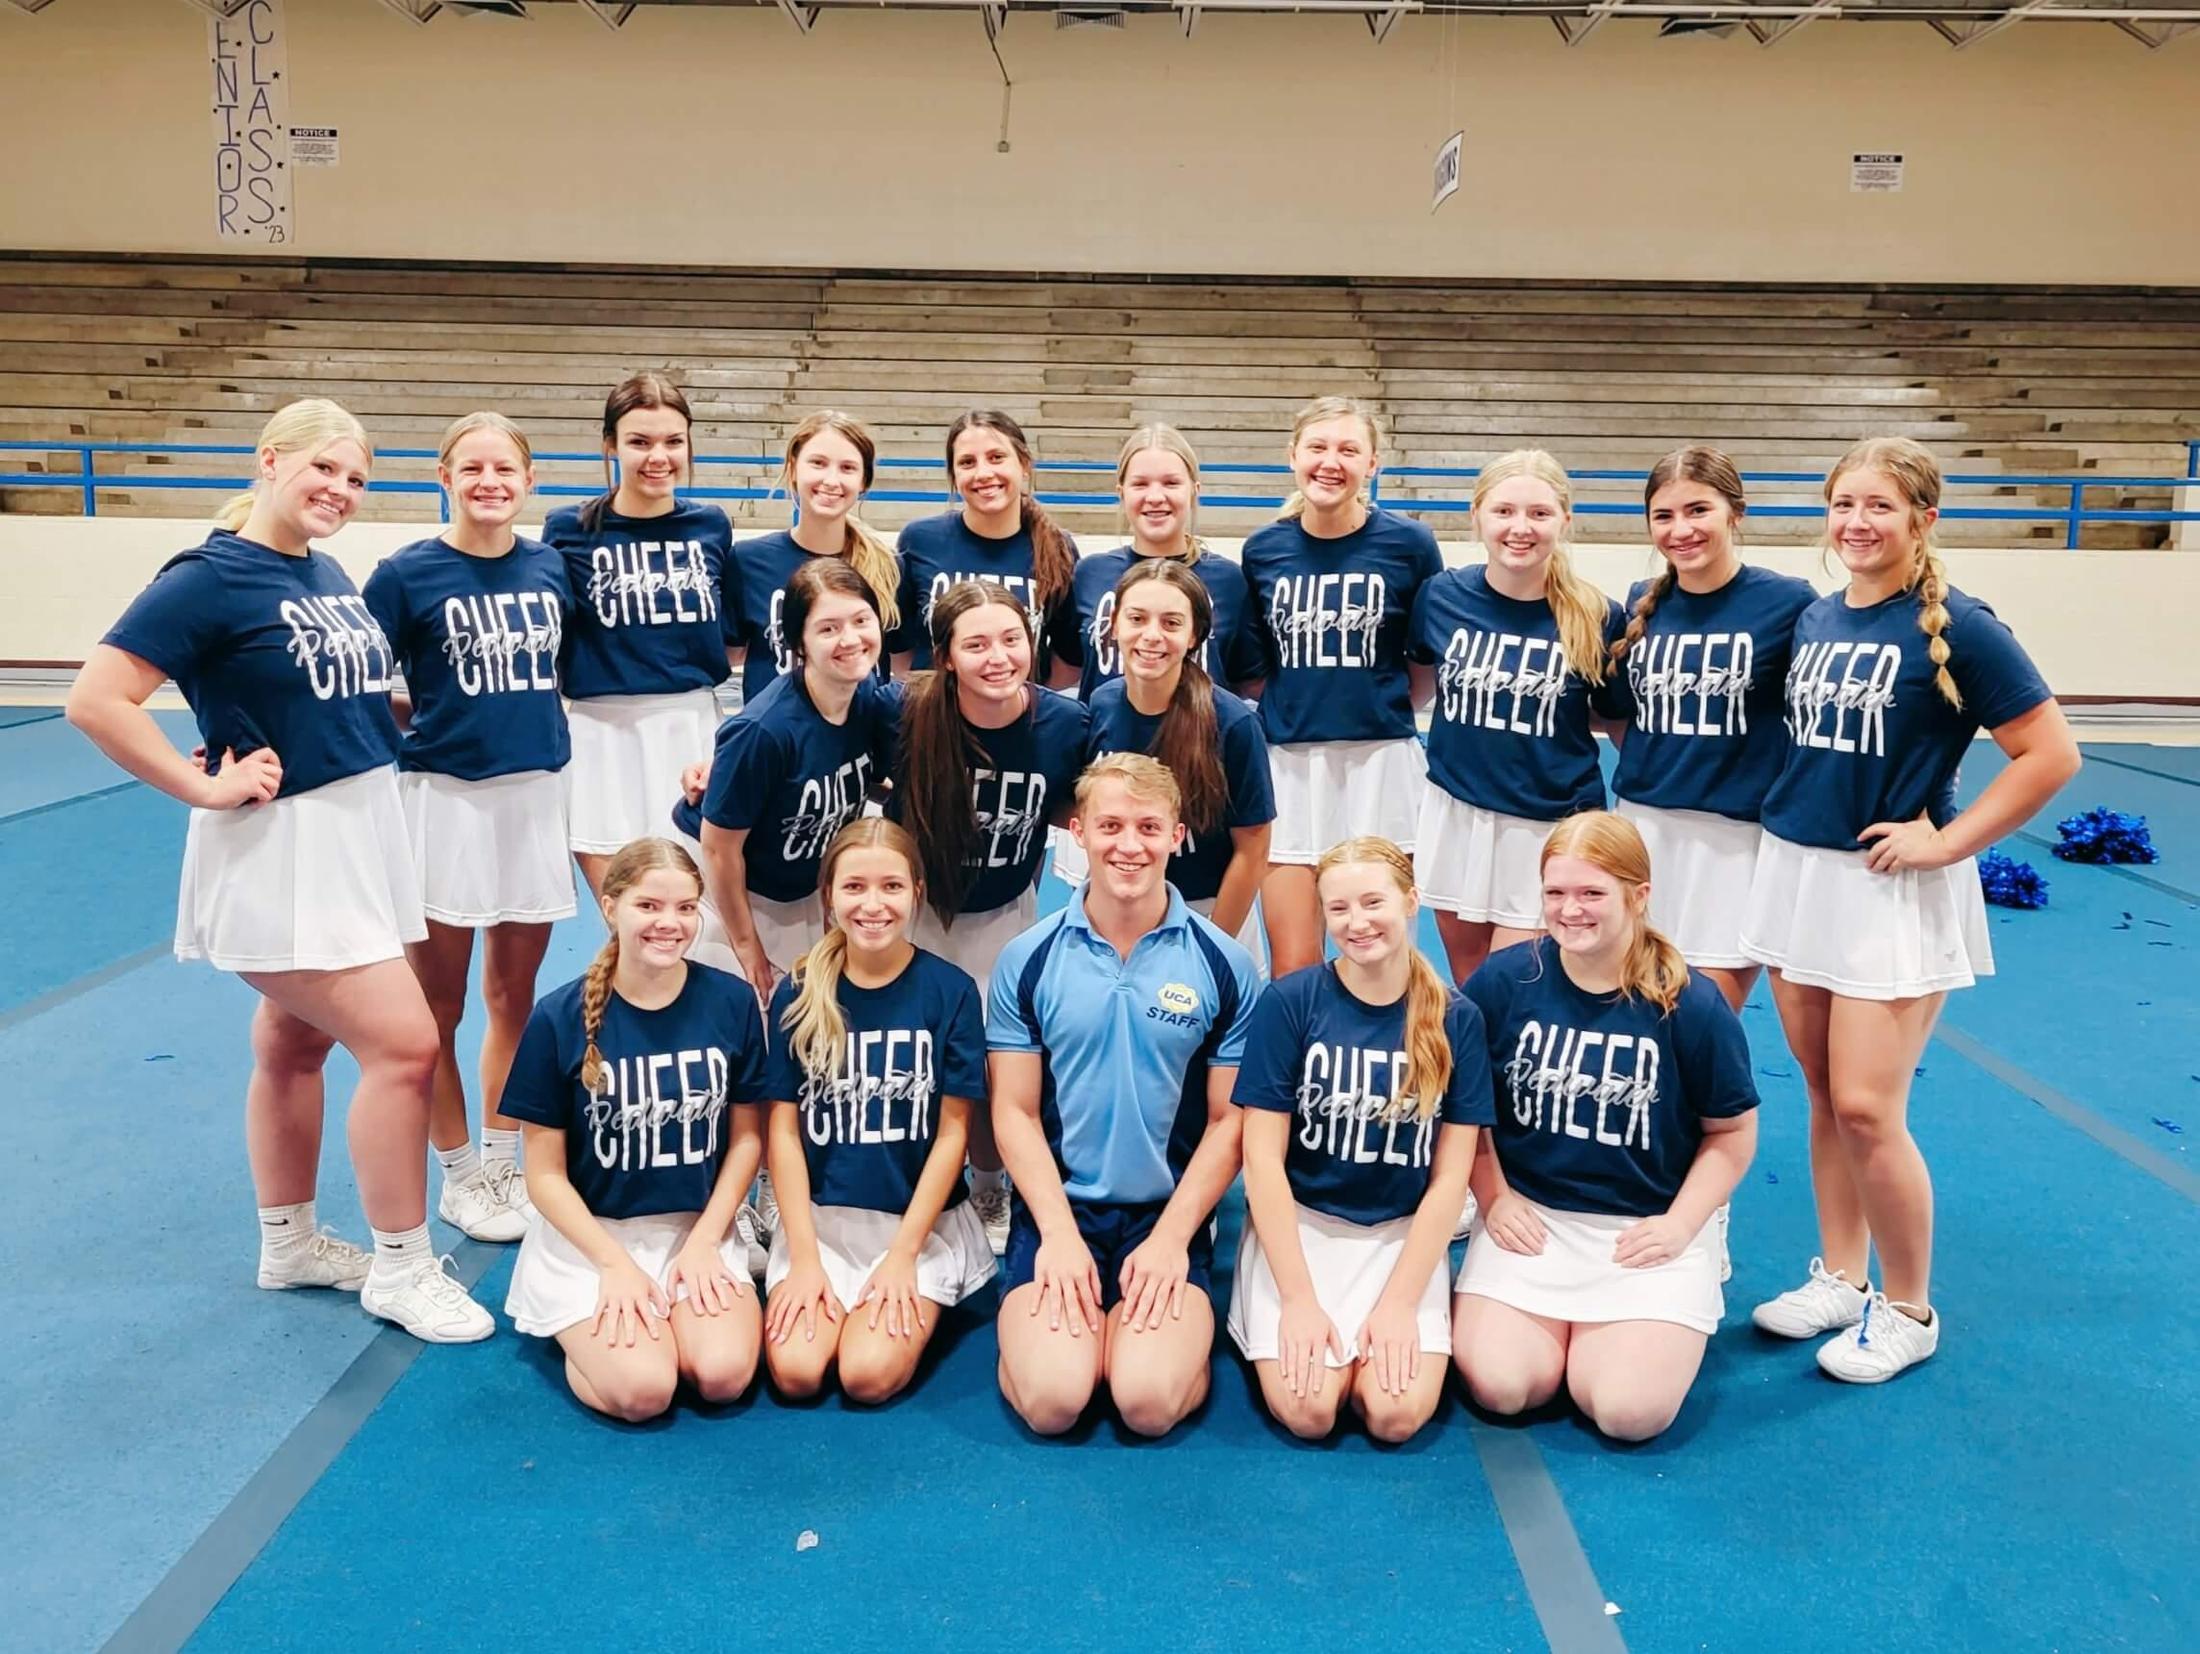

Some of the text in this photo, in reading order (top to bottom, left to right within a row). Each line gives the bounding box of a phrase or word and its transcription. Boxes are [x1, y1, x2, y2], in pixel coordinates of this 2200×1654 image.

[216, 21, 241, 234] ENIOR
[248, 0, 274, 224] CLASS
[295, 129, 330, 137] NOTICE
[592, 540, 716, 628] CHEER
[1272, 573, 1385, 669] CHEER
[445, 592, 562, 696] CHEER
[1443, 628, 1567, 737] CHEER
[1627, 632, 1753, 736] CHEER
[1146, 1007, 1200, 1029] STAFF
[1164, 990, 1192, 1006] UCA
[594, 1047, 728, 1172] CHEER
[1504, 1058, 1660, 1107] Redwater
[1513, 1021, 1659, 1150] CHEER
